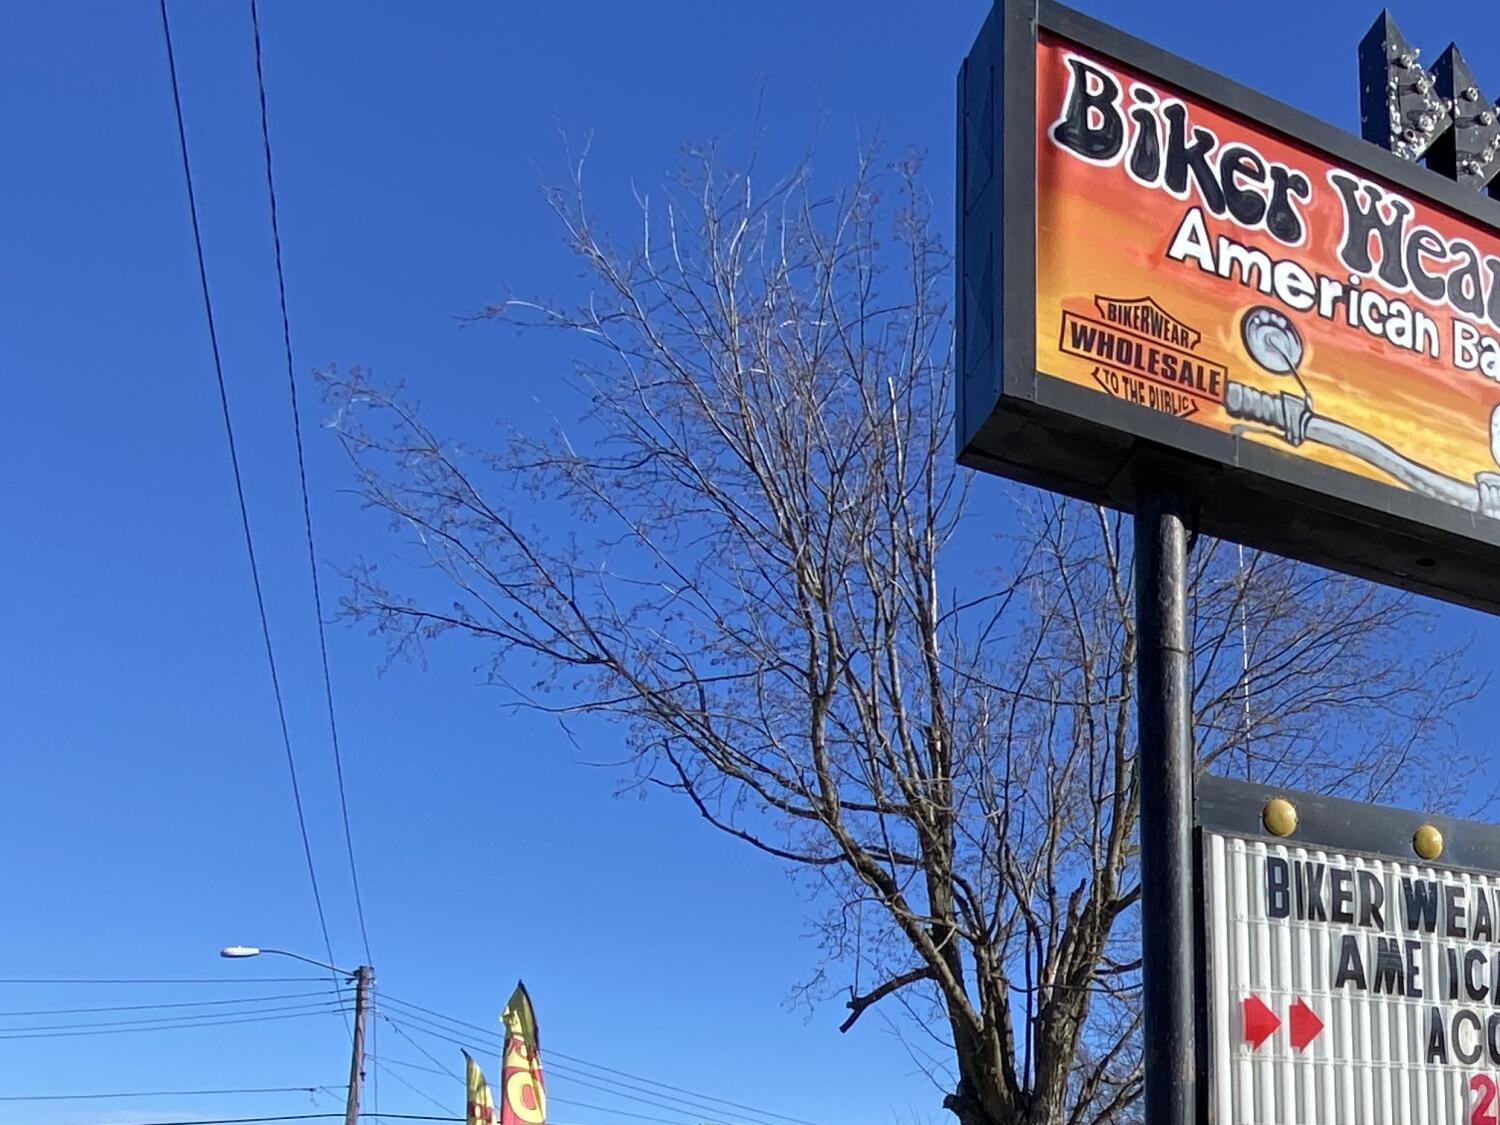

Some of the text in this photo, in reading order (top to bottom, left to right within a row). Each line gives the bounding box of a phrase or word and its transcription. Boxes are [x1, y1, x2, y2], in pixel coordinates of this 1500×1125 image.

[1048, 52, 1312, 246] Biker
[1166, 205, 1442, 360] American
[1070, 321, 1222, 397] WHOLESALE
[1107, 302, 1190, 348] BIKERWEAR
[1103, 368, 1119, 395] TO
[1121, 375, 1146, 405] THE
[1266, 855, 1385, 933] BIKER
